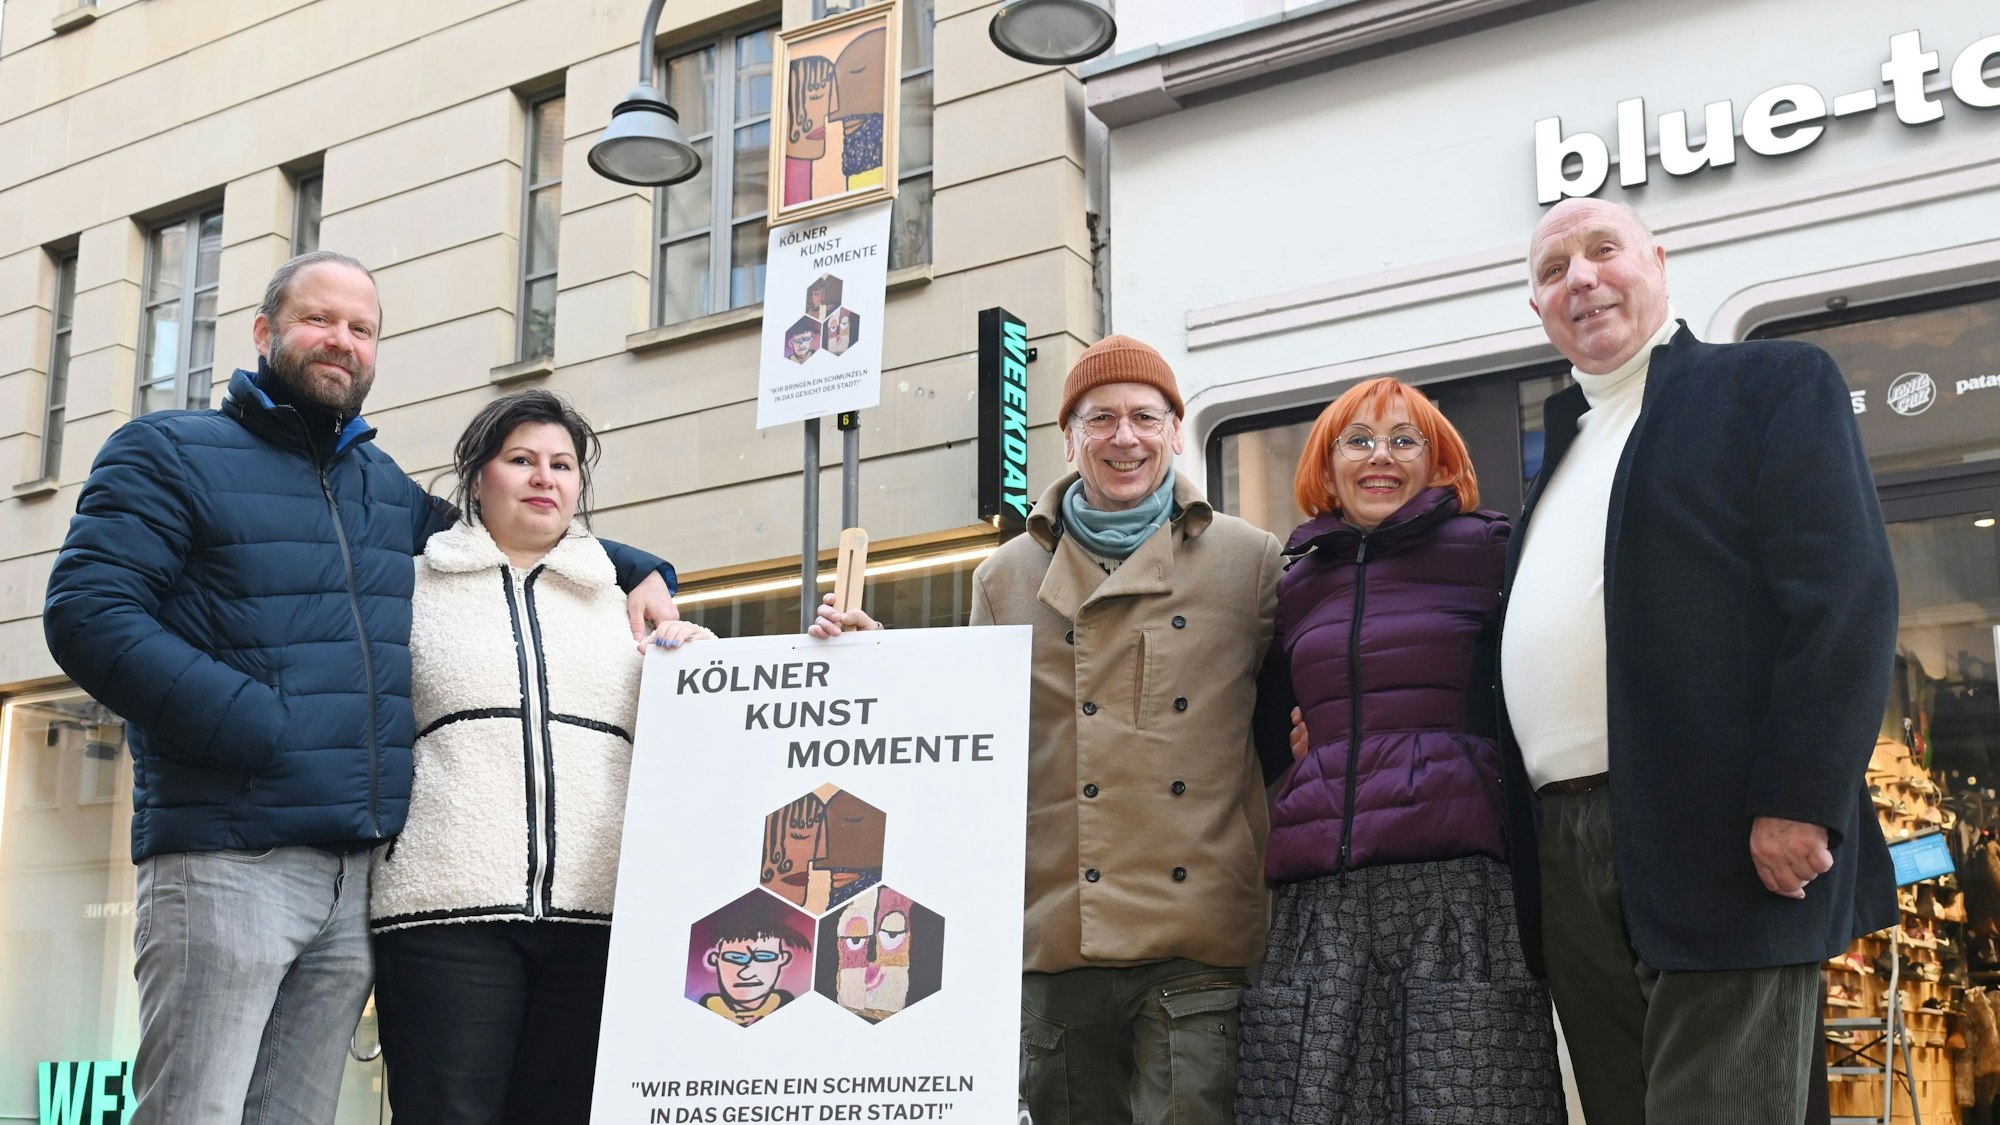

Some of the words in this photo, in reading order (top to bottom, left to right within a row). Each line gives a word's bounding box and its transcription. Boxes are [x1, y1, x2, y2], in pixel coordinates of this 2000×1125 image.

[779, 226, 827, 247] KÖLNER
[800, 237, 842, 257] KUNST
[813, 244, 878, 269] MOMENTE
[784, 380, 812, 392] BRINGEN
[812, 378, 823, 386] EIN
[824, 369, 868, 383] SCHMUNZELN
[1956, 375, 2000, 395] pata
[774, 395, 781, 403] IN
[781, 393, 794, 401] DAS
[795, 387, 822, 398] GESICHT
[822, 384, 836, 392] DER
[842, 414, 850, 426] 6
[1003, 321, 1027, 518] WEEKDAY
[676, 660, 831, 695] KÖLNER
[745, 698, 878, 730] KUNST
[787, 733, 994, 769] MOMENTE
[631, 1080, 681, 1098] "WIR
[686, 1079, 778, 1097] BRINGEN
[783, 1078, 818, 1094] EIN
[822, 1075, 973, 1094] SCHMUNZELN
[650, 1108, 671, 1124] IN
[675, 1107, 717, 1124] DAS
[722, 1105, 814, 1123] GESICHT
[819, 1104, 862, 1121] DER
[867, 1103, 953, 1121] STADT!"
